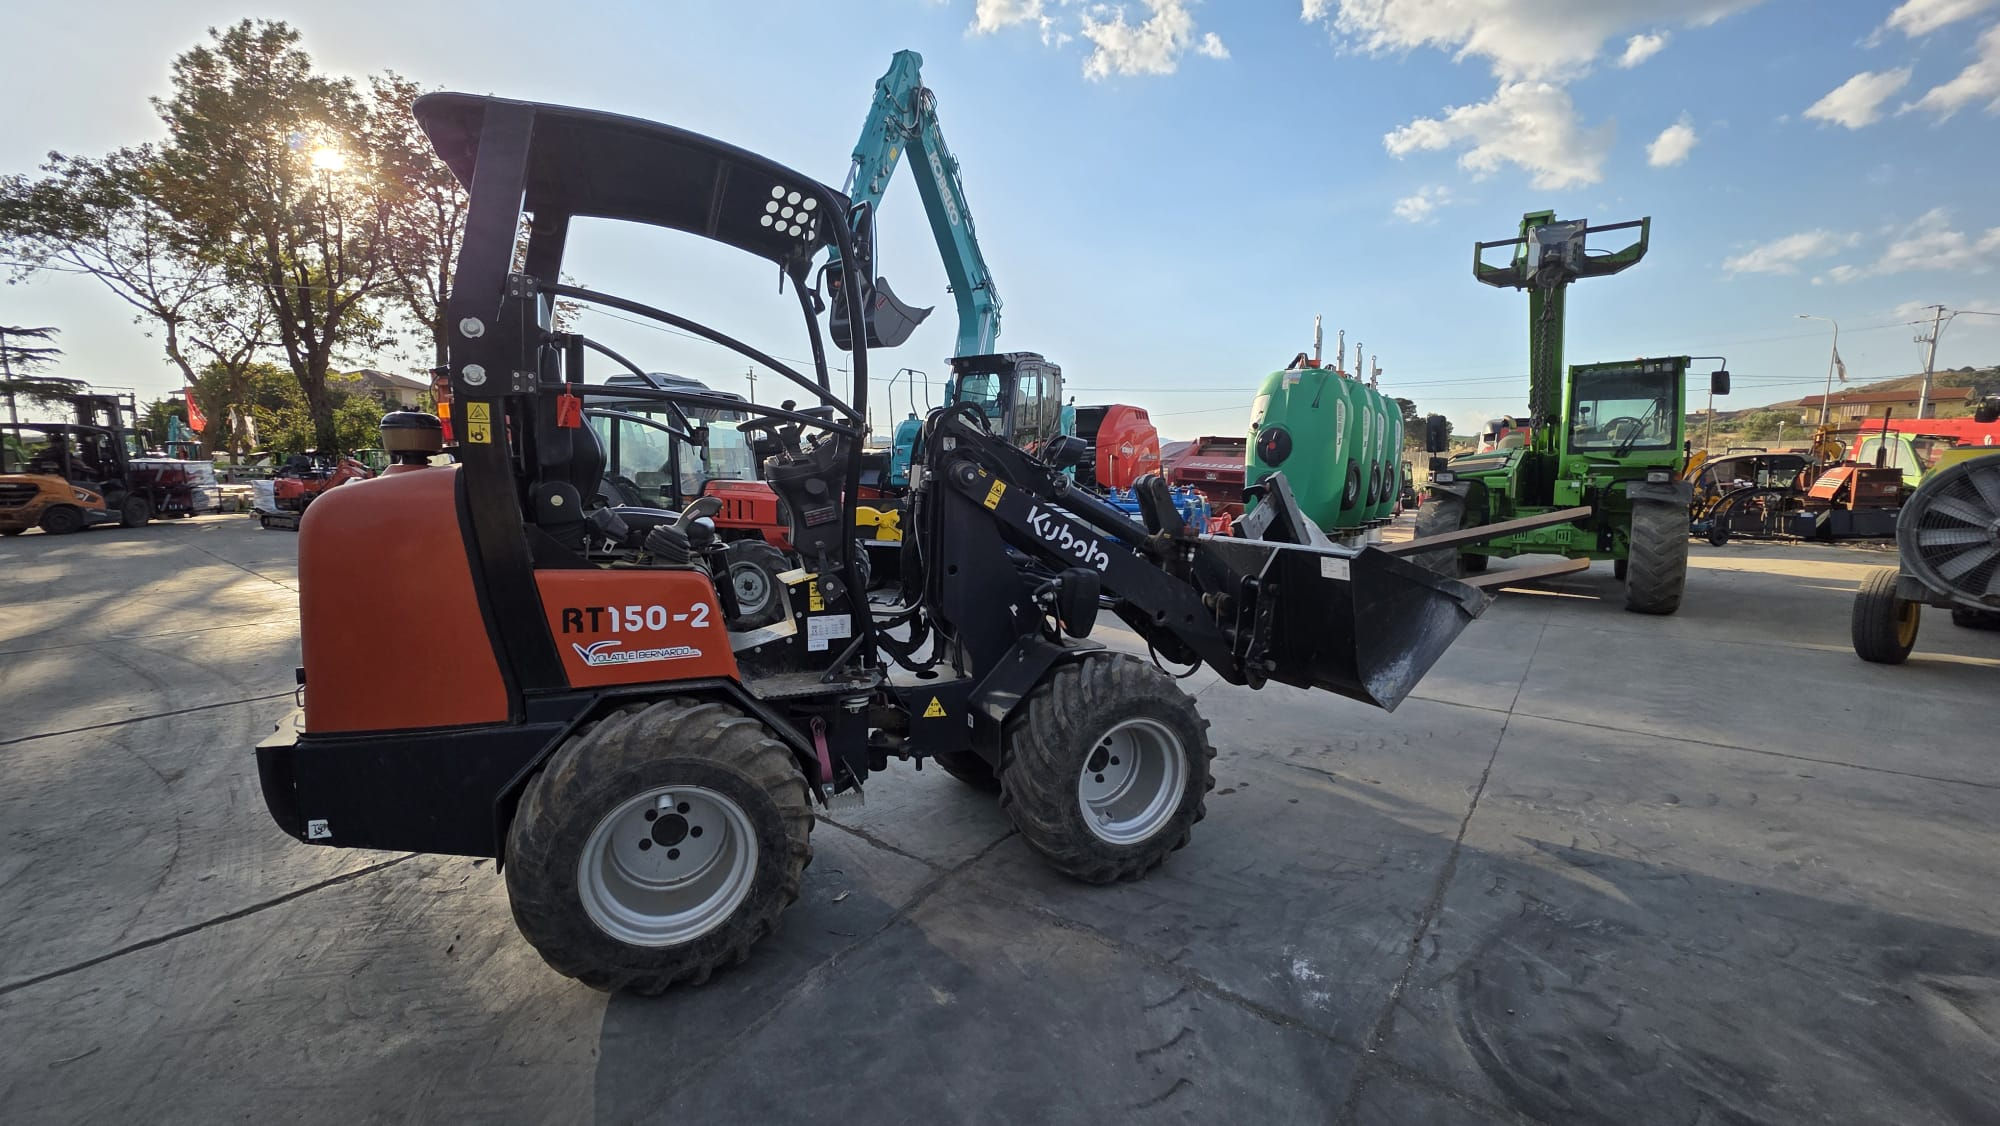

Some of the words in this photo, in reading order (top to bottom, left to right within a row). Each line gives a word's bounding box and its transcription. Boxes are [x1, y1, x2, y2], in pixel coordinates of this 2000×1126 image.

[929, 150, 958, 226] KOBELCO
[1026, 505, 1109, 572] Kubota
[562, 602, 710, 633] RT150-2
[591, 651, 635, 662] VOLATILE
[638, 647, 689, 659] BERNARDO
